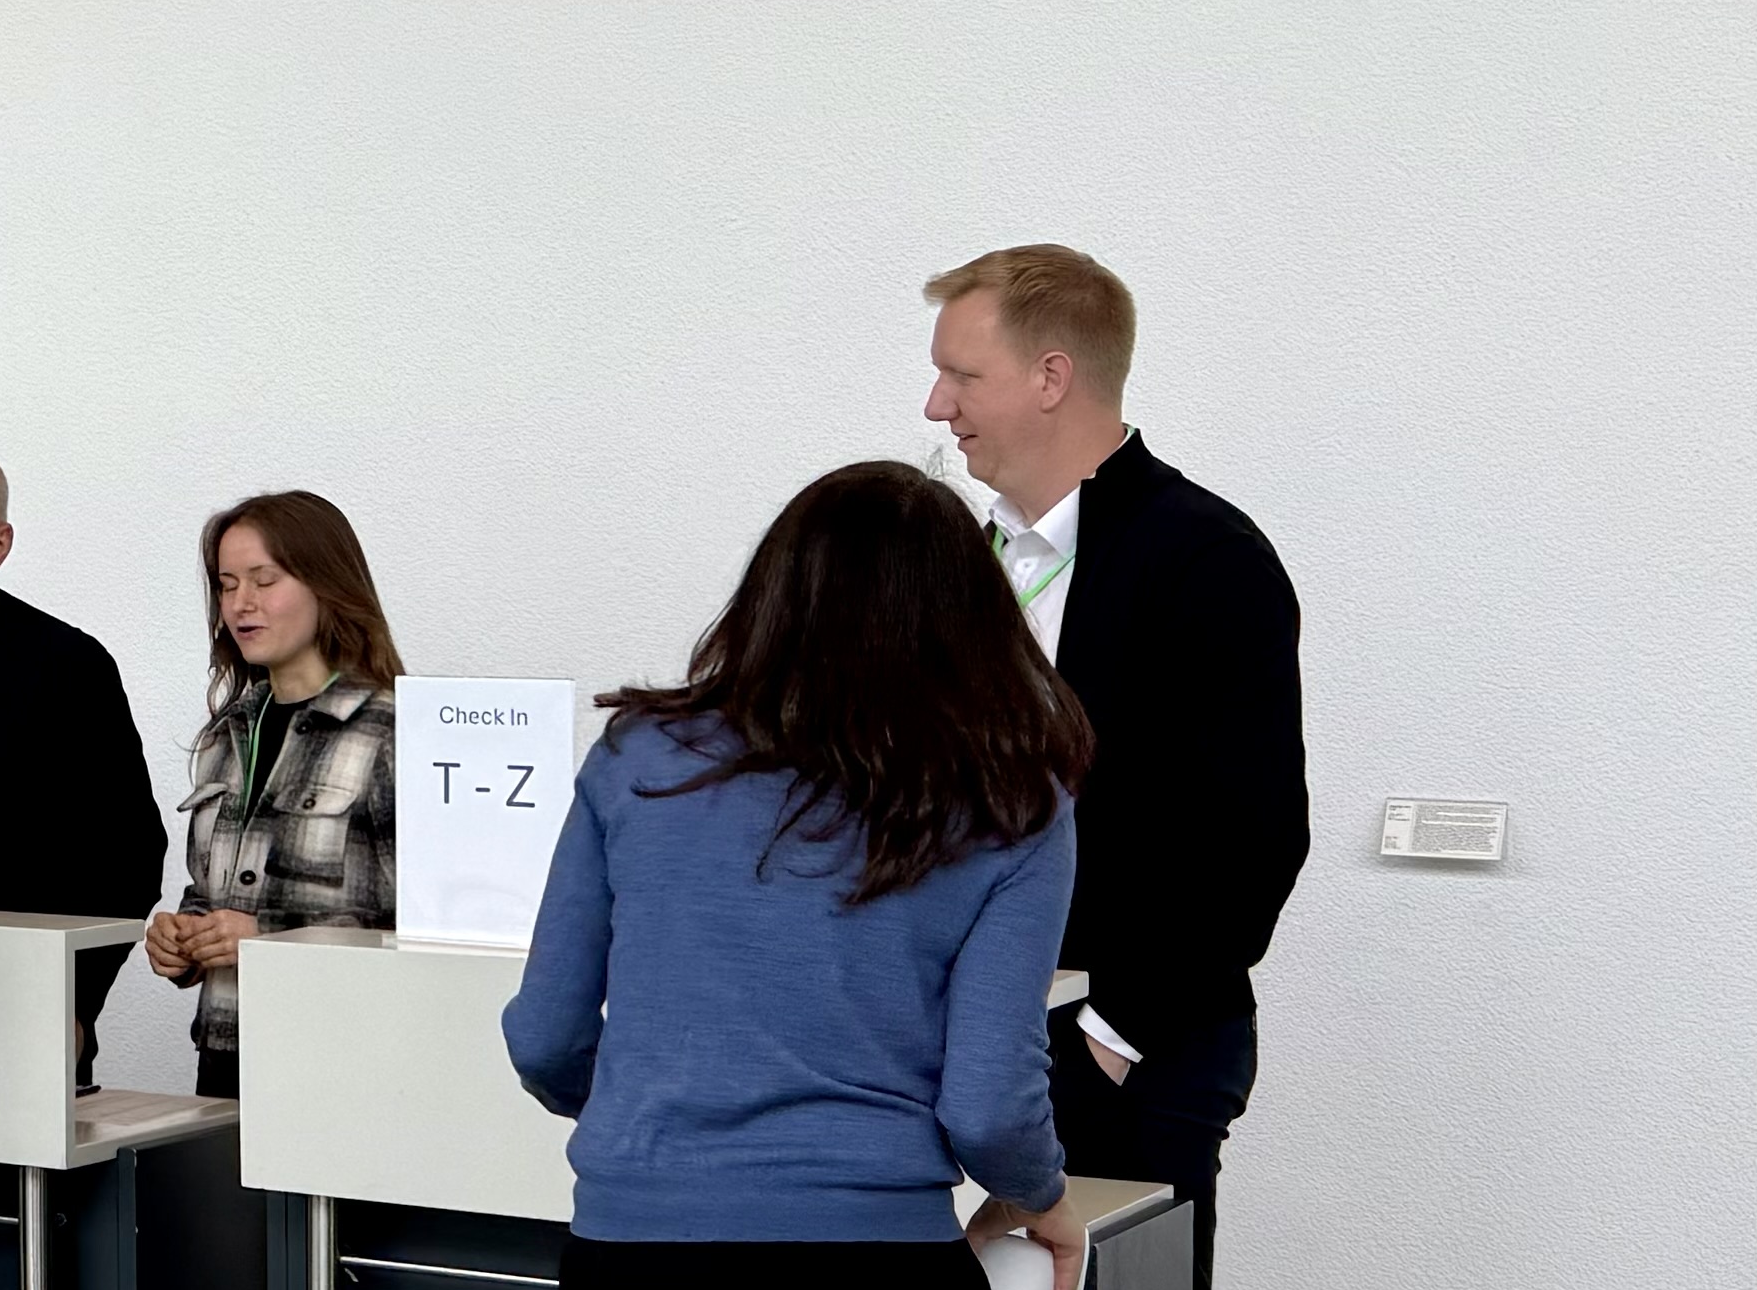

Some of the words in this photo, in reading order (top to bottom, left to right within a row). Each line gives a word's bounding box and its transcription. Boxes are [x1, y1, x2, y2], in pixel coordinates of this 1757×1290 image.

[440, 706, 505, 725] Check
[511, 709, 528, 726] In
[433, 762, 461, 804] T
[506, 765, 535, 808] Z
